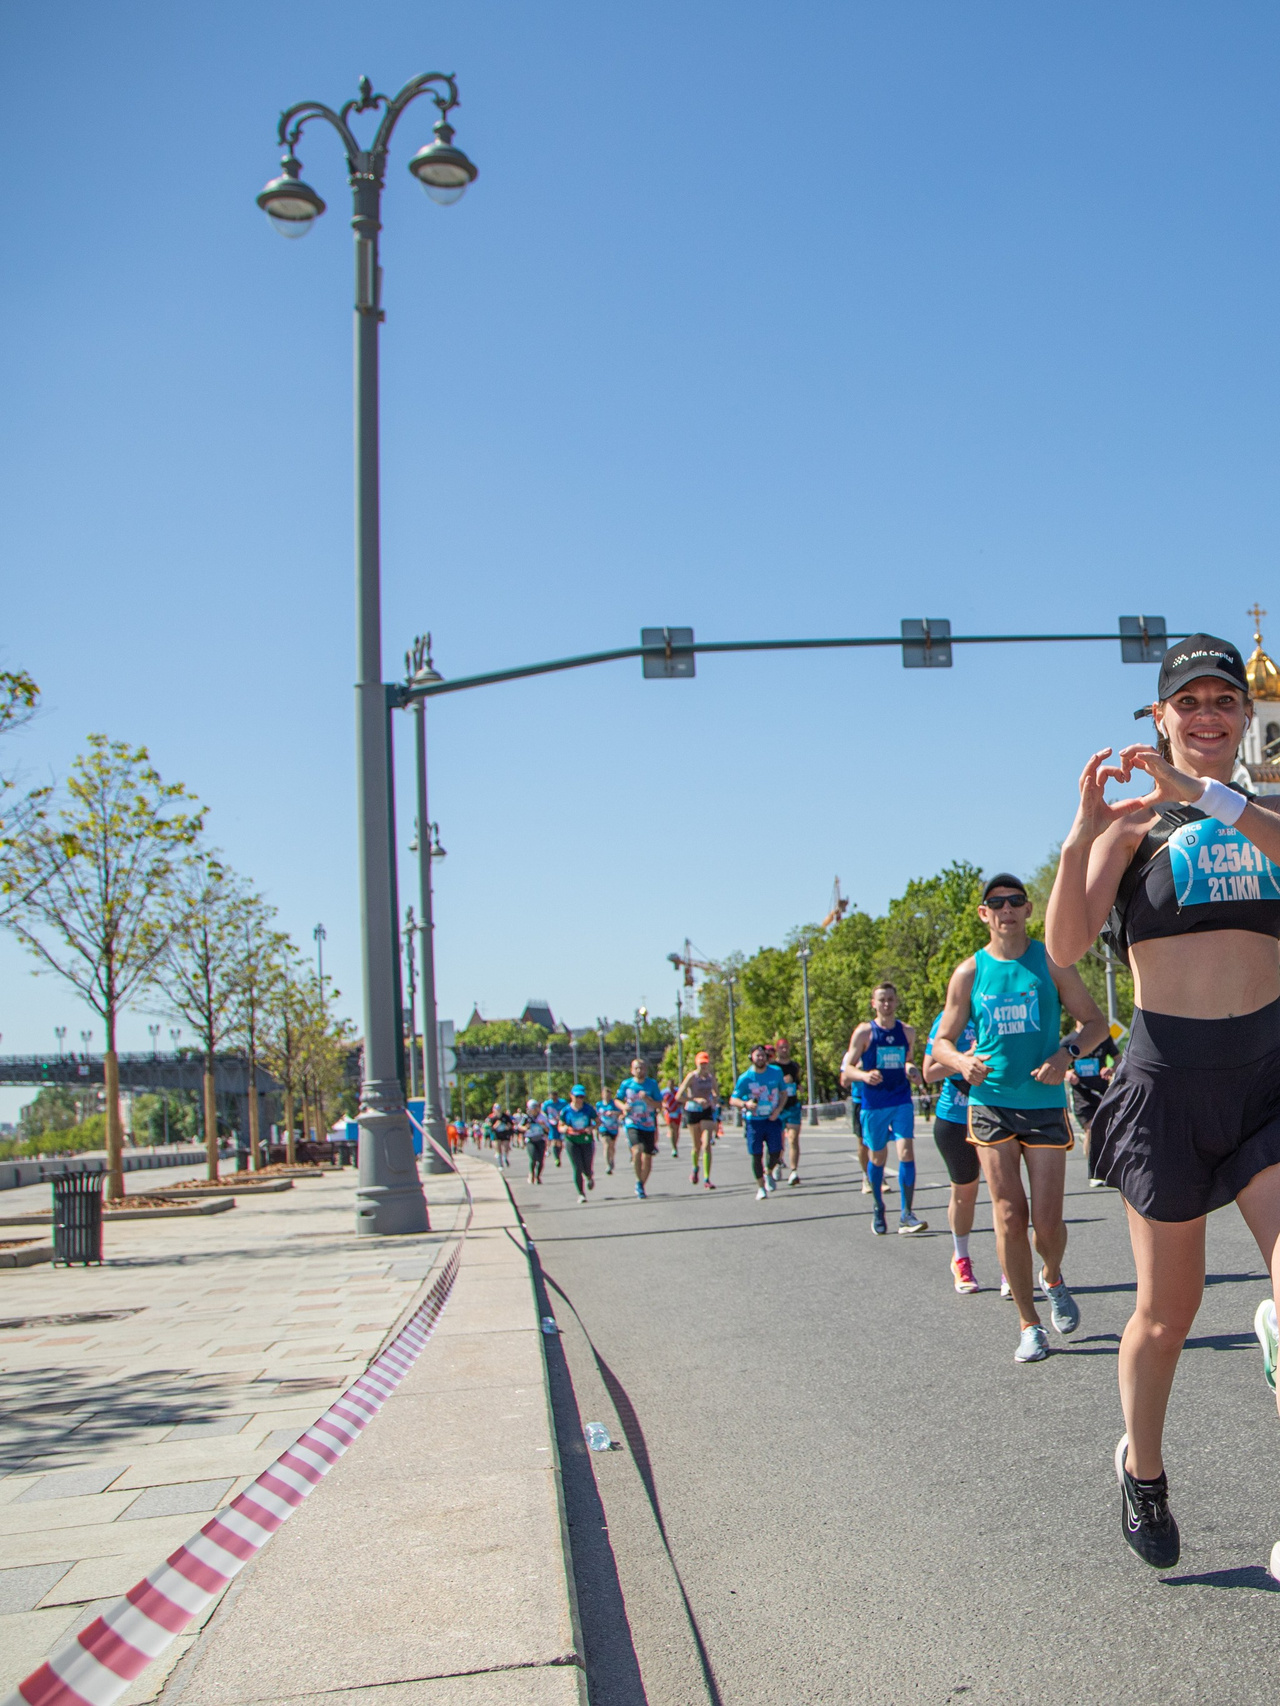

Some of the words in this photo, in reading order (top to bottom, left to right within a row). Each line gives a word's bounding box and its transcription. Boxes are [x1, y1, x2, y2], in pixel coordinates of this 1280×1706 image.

[1191, 650, 1207, 659] Alfa
[1209, 650, 1234, 664] Capital
[1198, 842, 1263, 874] 42541
[993, 1004, 1028, 1022] 41700
